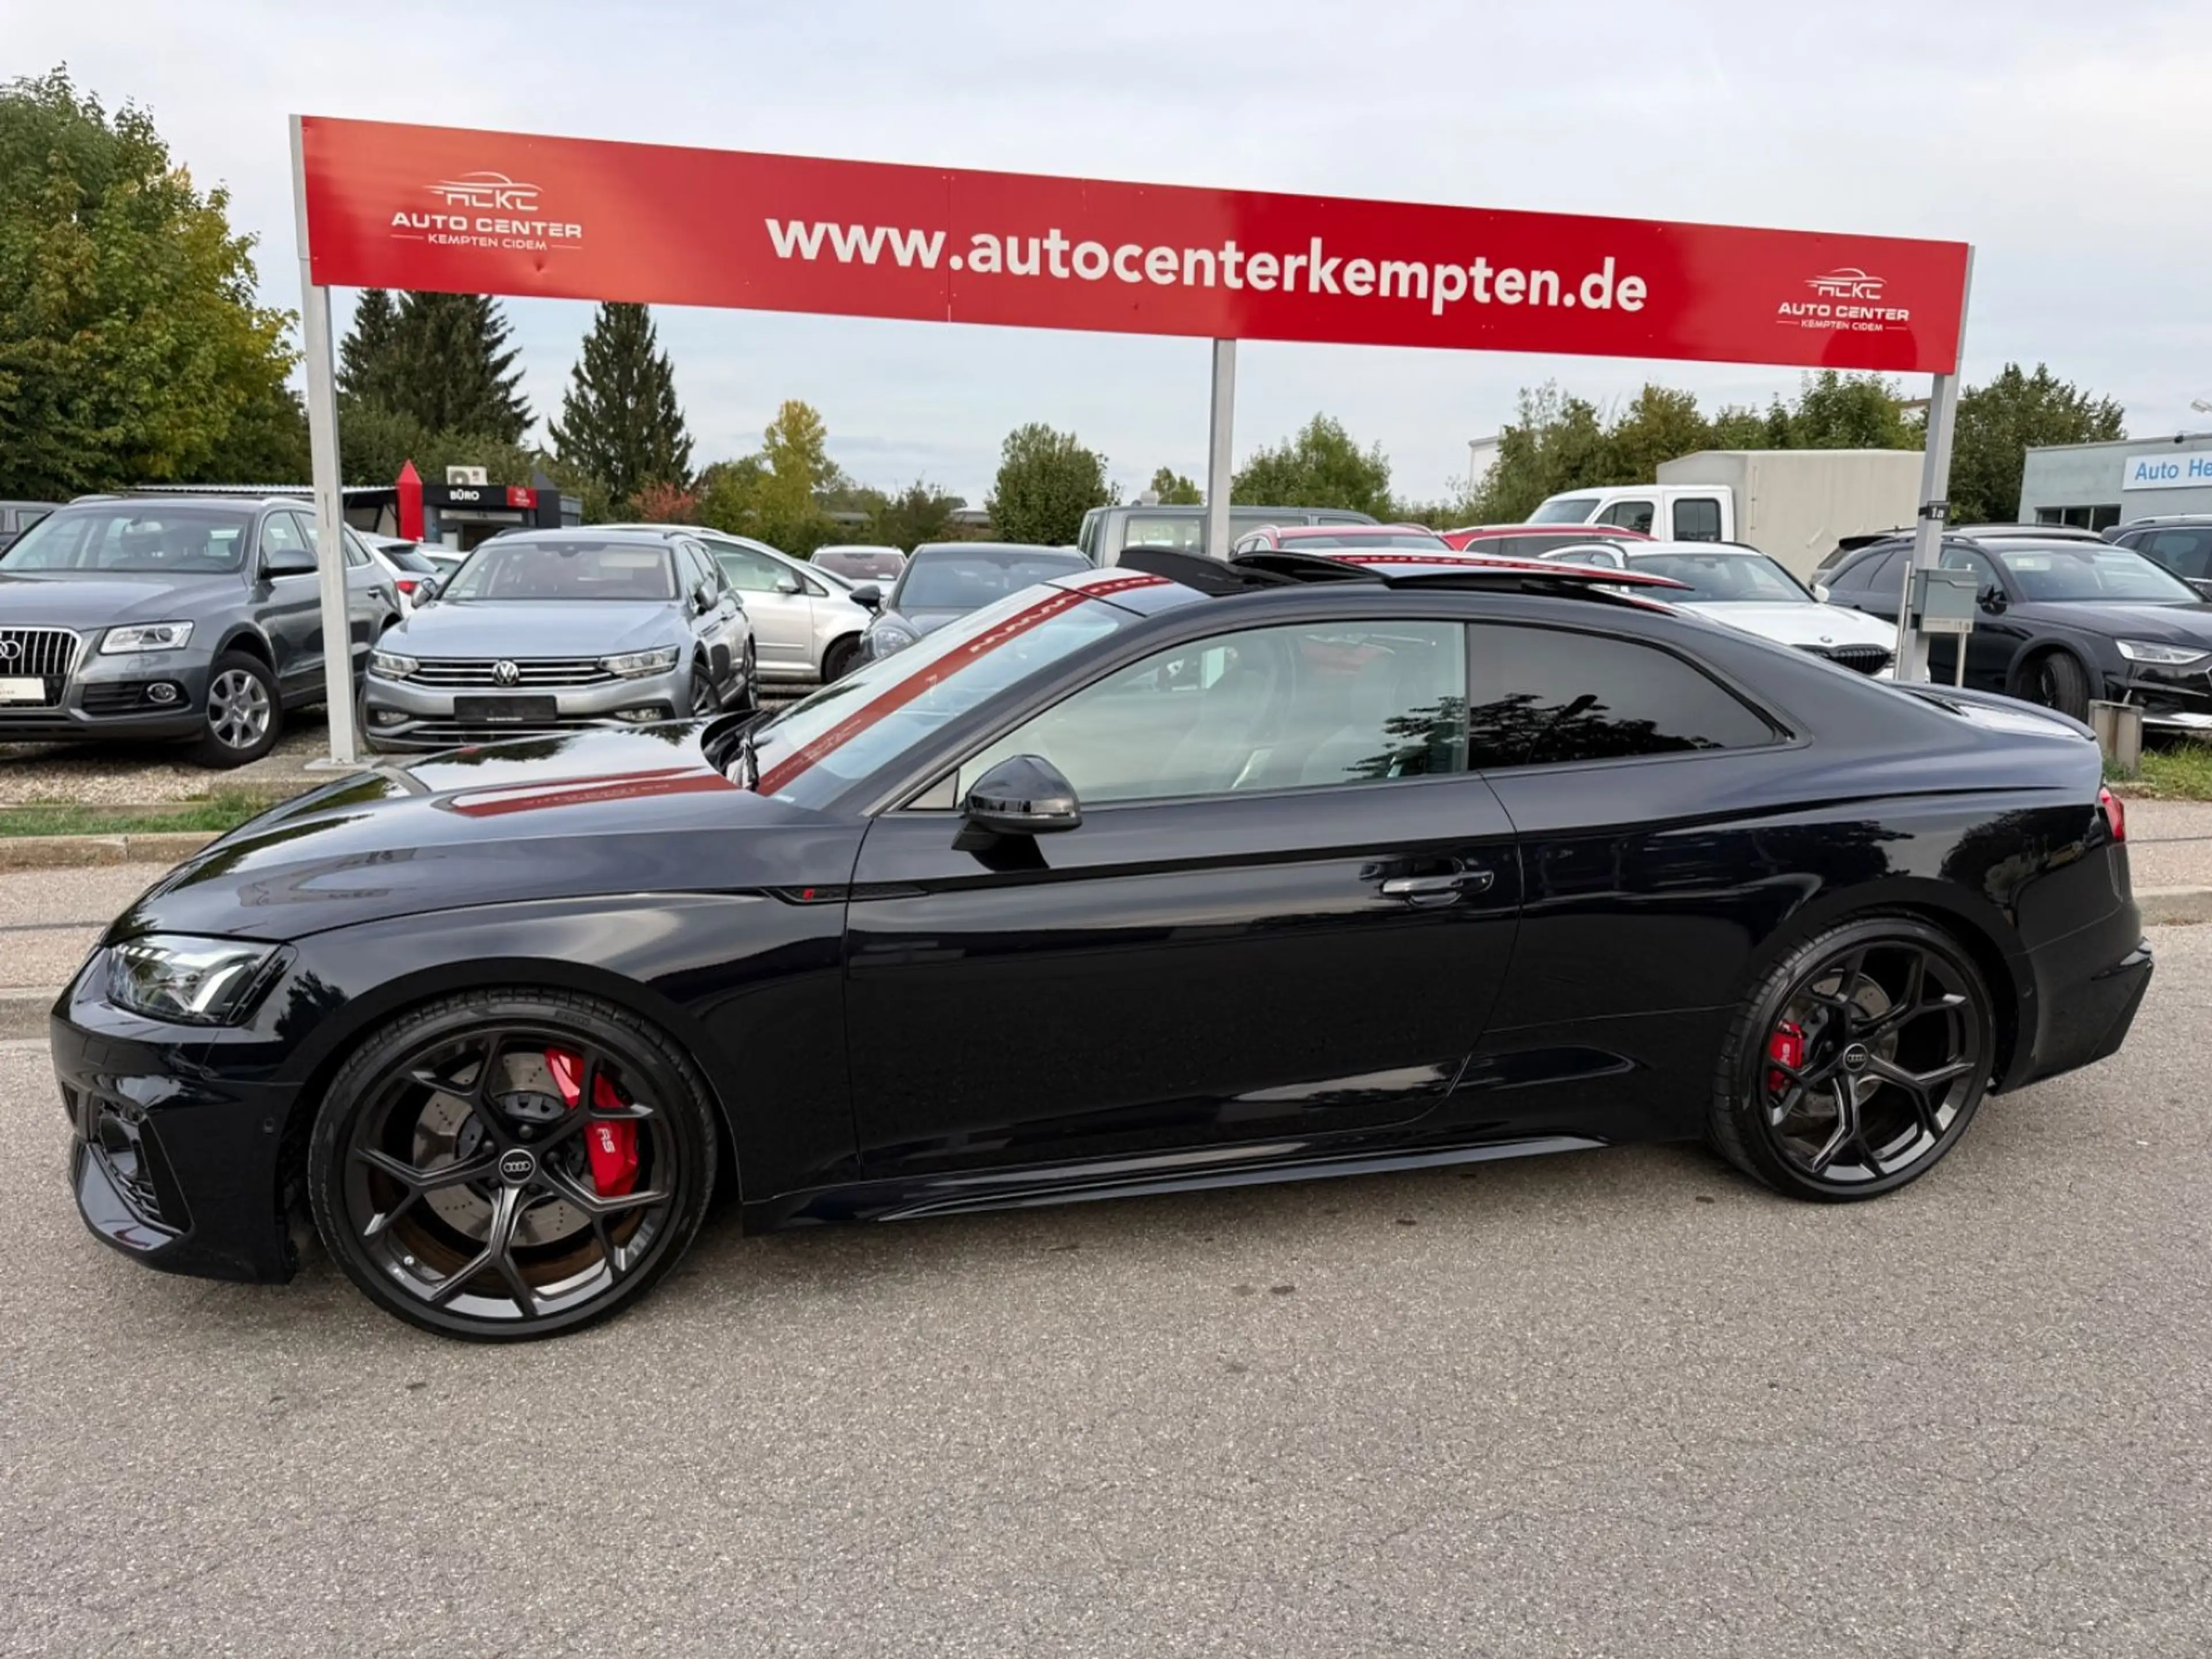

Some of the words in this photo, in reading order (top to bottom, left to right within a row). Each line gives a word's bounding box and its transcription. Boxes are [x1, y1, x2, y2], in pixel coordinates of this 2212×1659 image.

[391, 211, 468, 230] AUTO
[475, 217, 582, 239] CENTER
[427, 233, 499, 248] KEMPTEN
[502, 238, 547, 251] CIDEM
[764, 217, 1647, 315] www.autocenterkempten.de
[1778, 302, 1831, 316] AUTO
[1835, 306, 1910, 321] CENTER
[1801, 319, 1850, 330] KEMPTEN
[1851, 323, 1883, 332] CIDEM
[2134, 461, 2179, 480] Auto
[449, 488, 480, 501] BÜRO
[597, 1127, 616, 1153] RS
